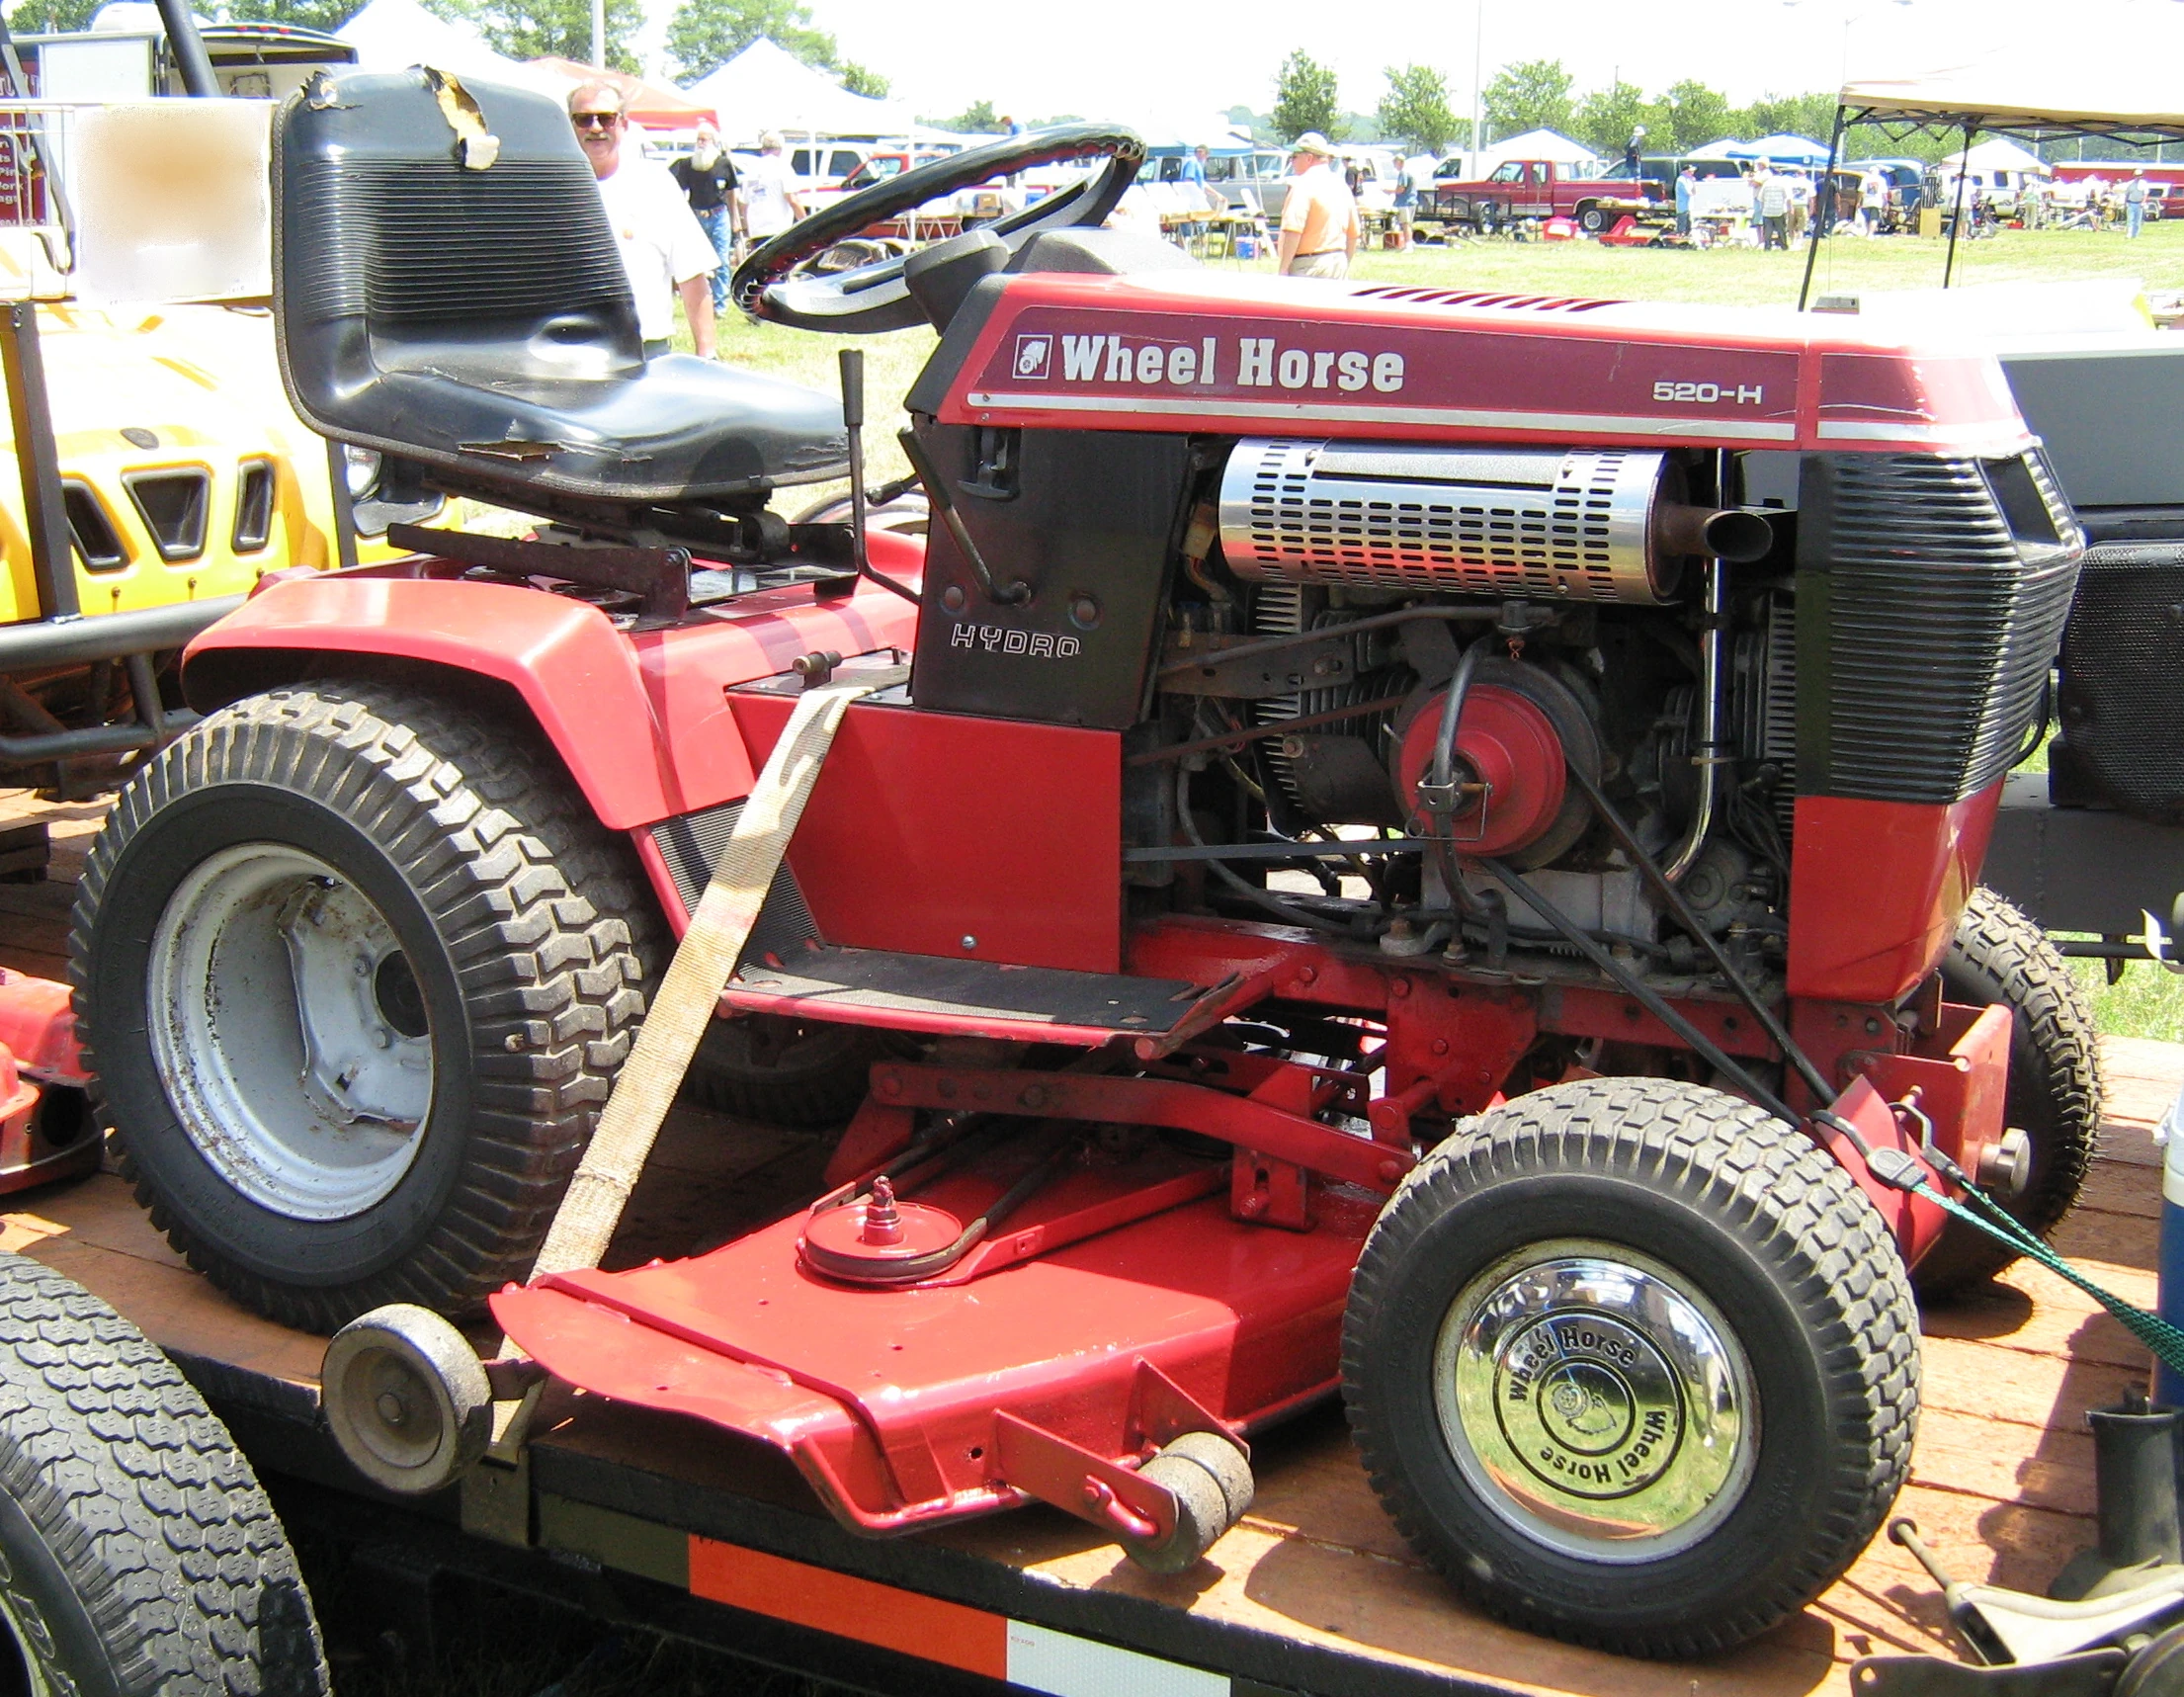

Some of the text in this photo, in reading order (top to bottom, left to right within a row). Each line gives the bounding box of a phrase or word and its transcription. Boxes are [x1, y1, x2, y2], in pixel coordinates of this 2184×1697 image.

[1061, 334, 1405, 392] Wheel Horse
[1652, 382, 1763, 405] 520-H
[951, 623, 1081, 658] HYDRO
[1508, 1325, 1637, 1401] Wheel Horse
[1540, 1410, 1667, 1484] Wheel Horse
